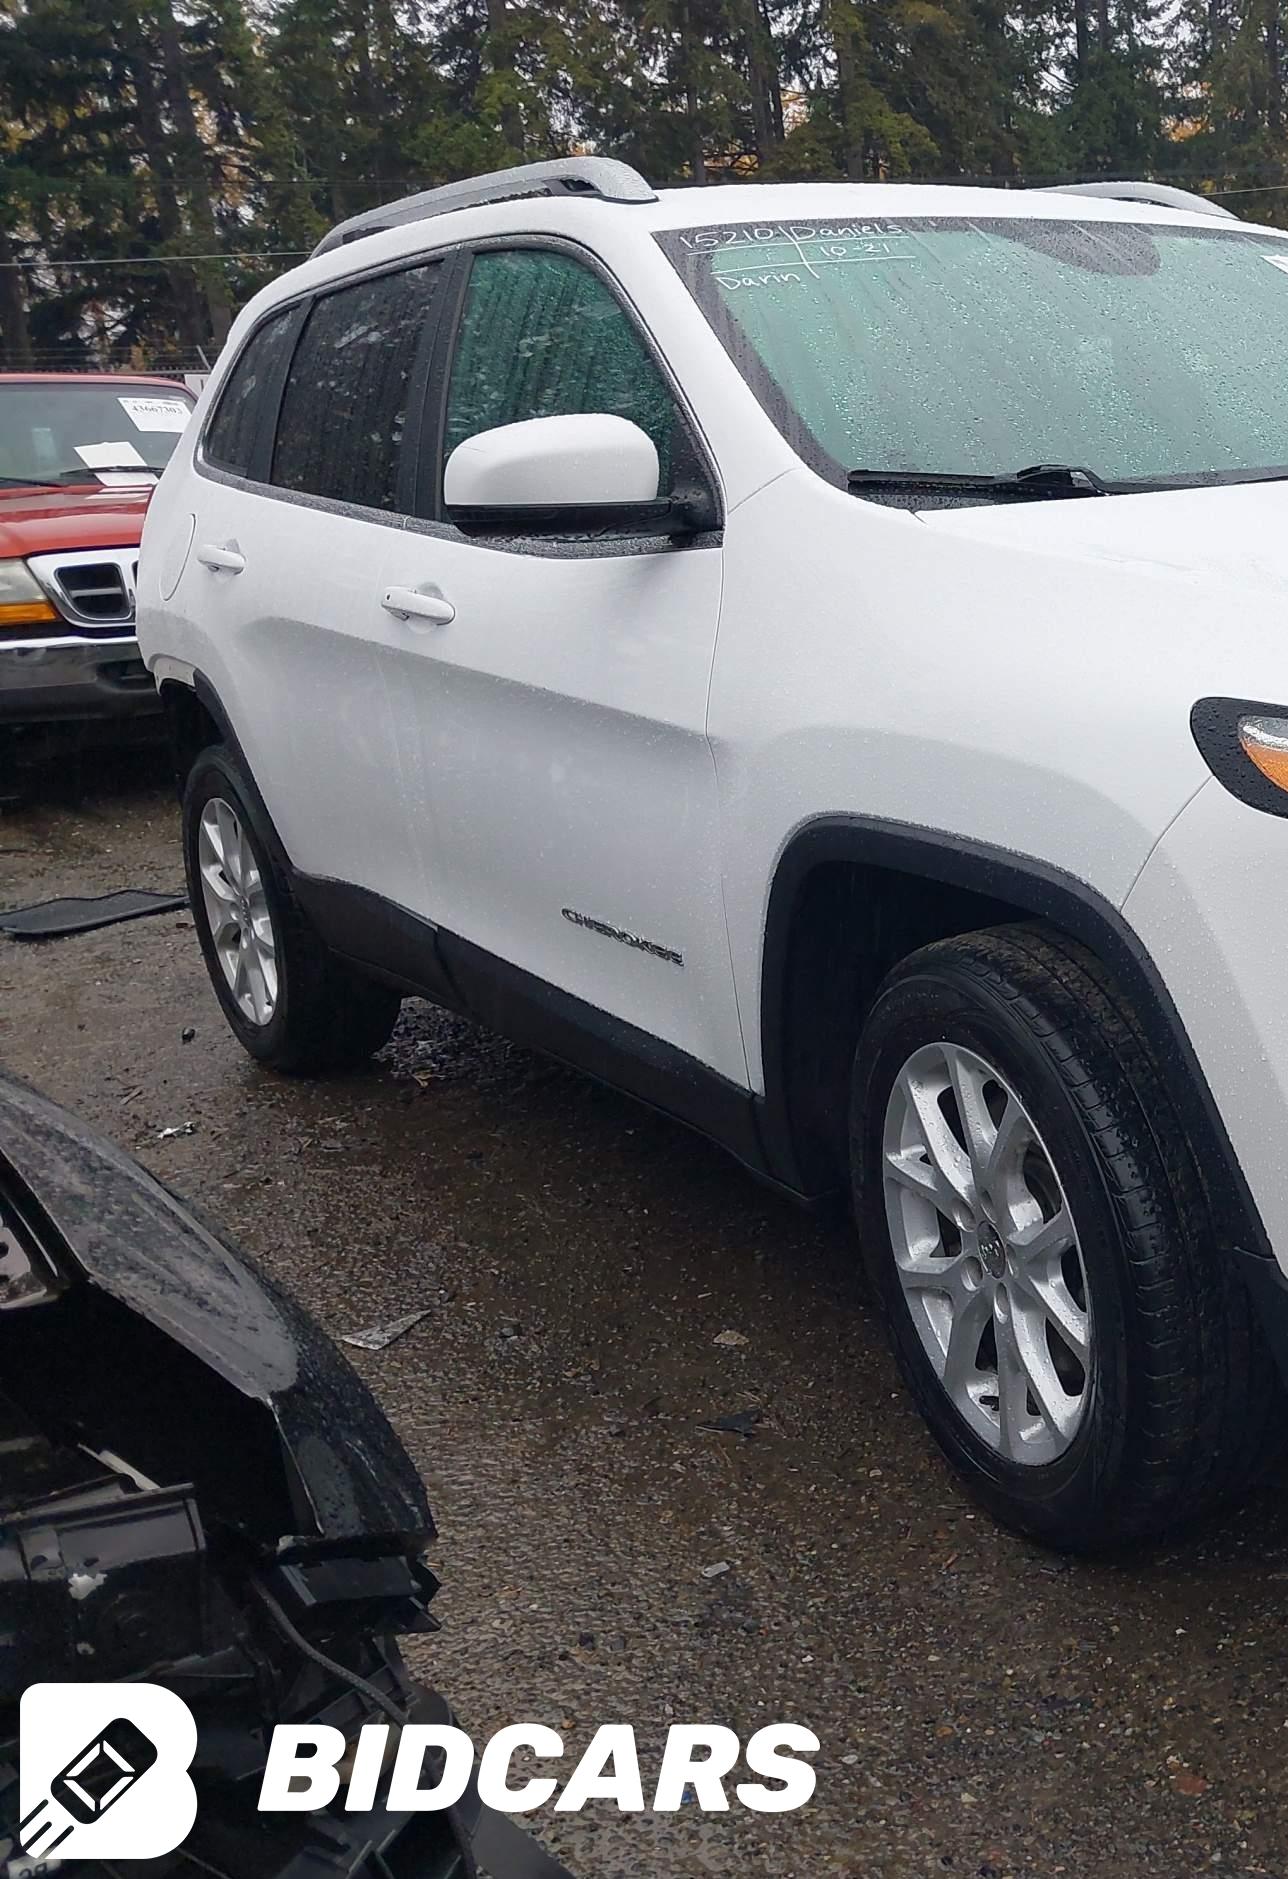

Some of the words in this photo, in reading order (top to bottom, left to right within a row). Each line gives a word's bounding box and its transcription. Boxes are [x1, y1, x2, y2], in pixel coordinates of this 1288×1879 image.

[680, 228, 774, 249] 15210
[789, 223, 903, 242] Daniels
[716, 272, 801, 290] Darin
